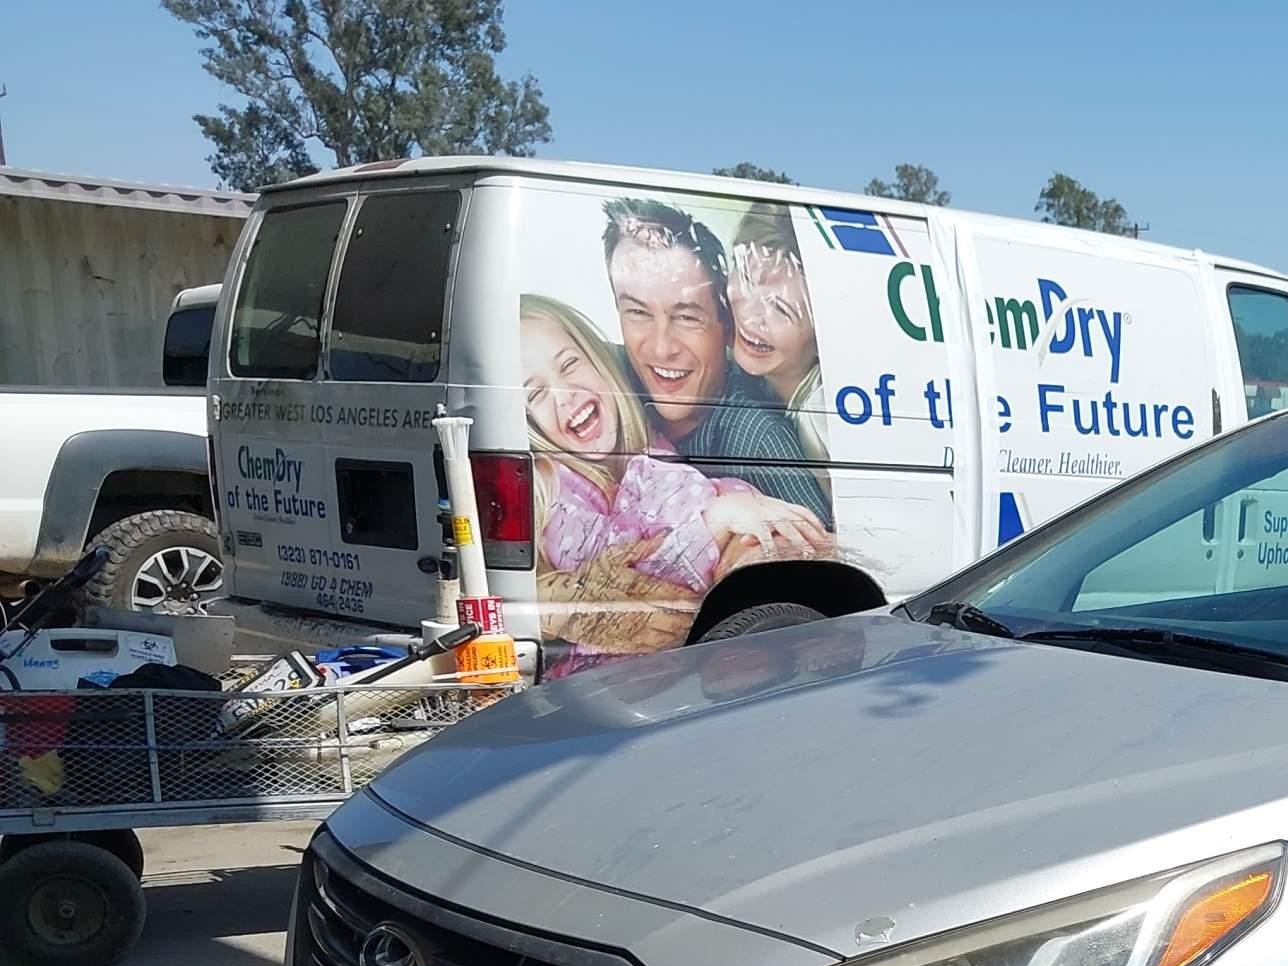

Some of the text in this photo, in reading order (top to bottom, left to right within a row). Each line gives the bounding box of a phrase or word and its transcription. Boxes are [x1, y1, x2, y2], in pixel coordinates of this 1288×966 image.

[223, 402, 272, 421] GREATER
[274, 403, 305, 422] WEST
[310, 405, 332, 424] LOS
[336, 406, 398, 428] ANGELES
[835, 373, 896, 426] of
[1037, 383, 1195, 439] Future
[237, 445, 302, 493] ChemDry
[1058, 451, 1123, 476] Healthier.
[227, 485, 326, 519] of the Future
[277, 545, 361, 571] (323) 871-0161
[281, 570, 308, 589] (888)
[339, 578, 374, 599] CHEM
